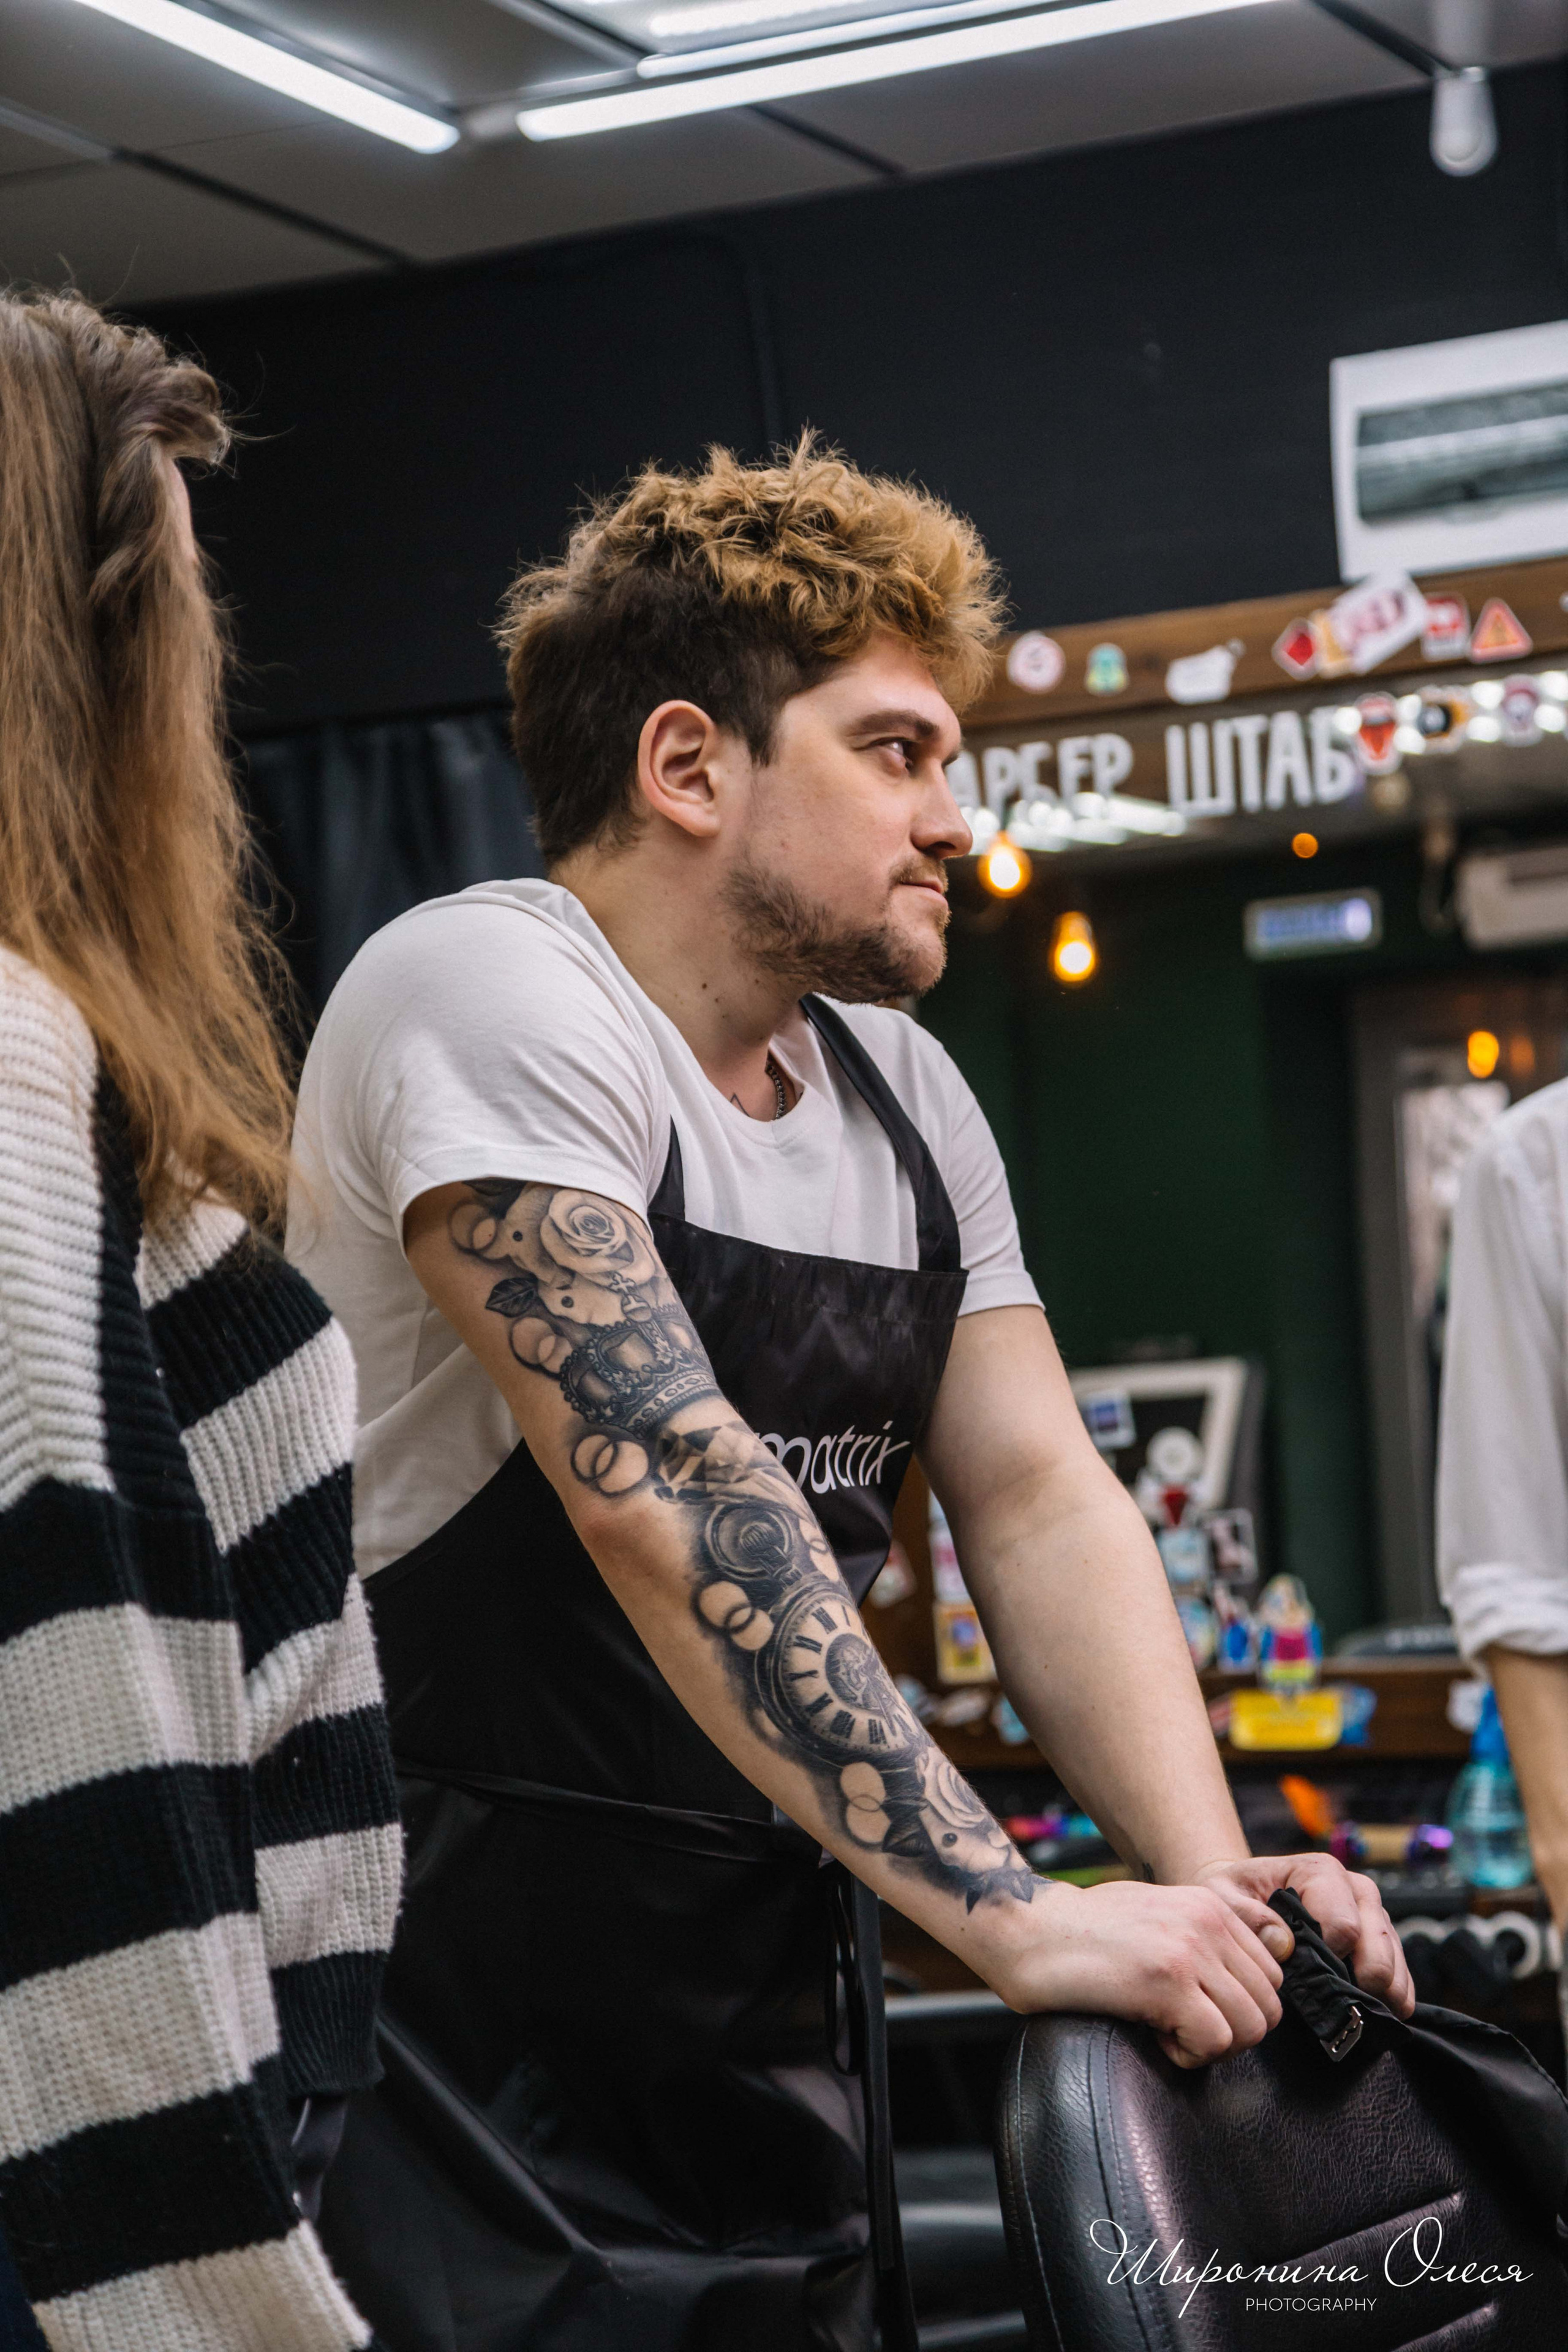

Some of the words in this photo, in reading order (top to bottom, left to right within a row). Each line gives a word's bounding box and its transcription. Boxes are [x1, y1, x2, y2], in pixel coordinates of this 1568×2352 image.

[944, 733, 1134, 828] АРБЕР
[1164, 705, 1354, 817] ШТАБ
[756, 1420, 910, 1494] matrix
